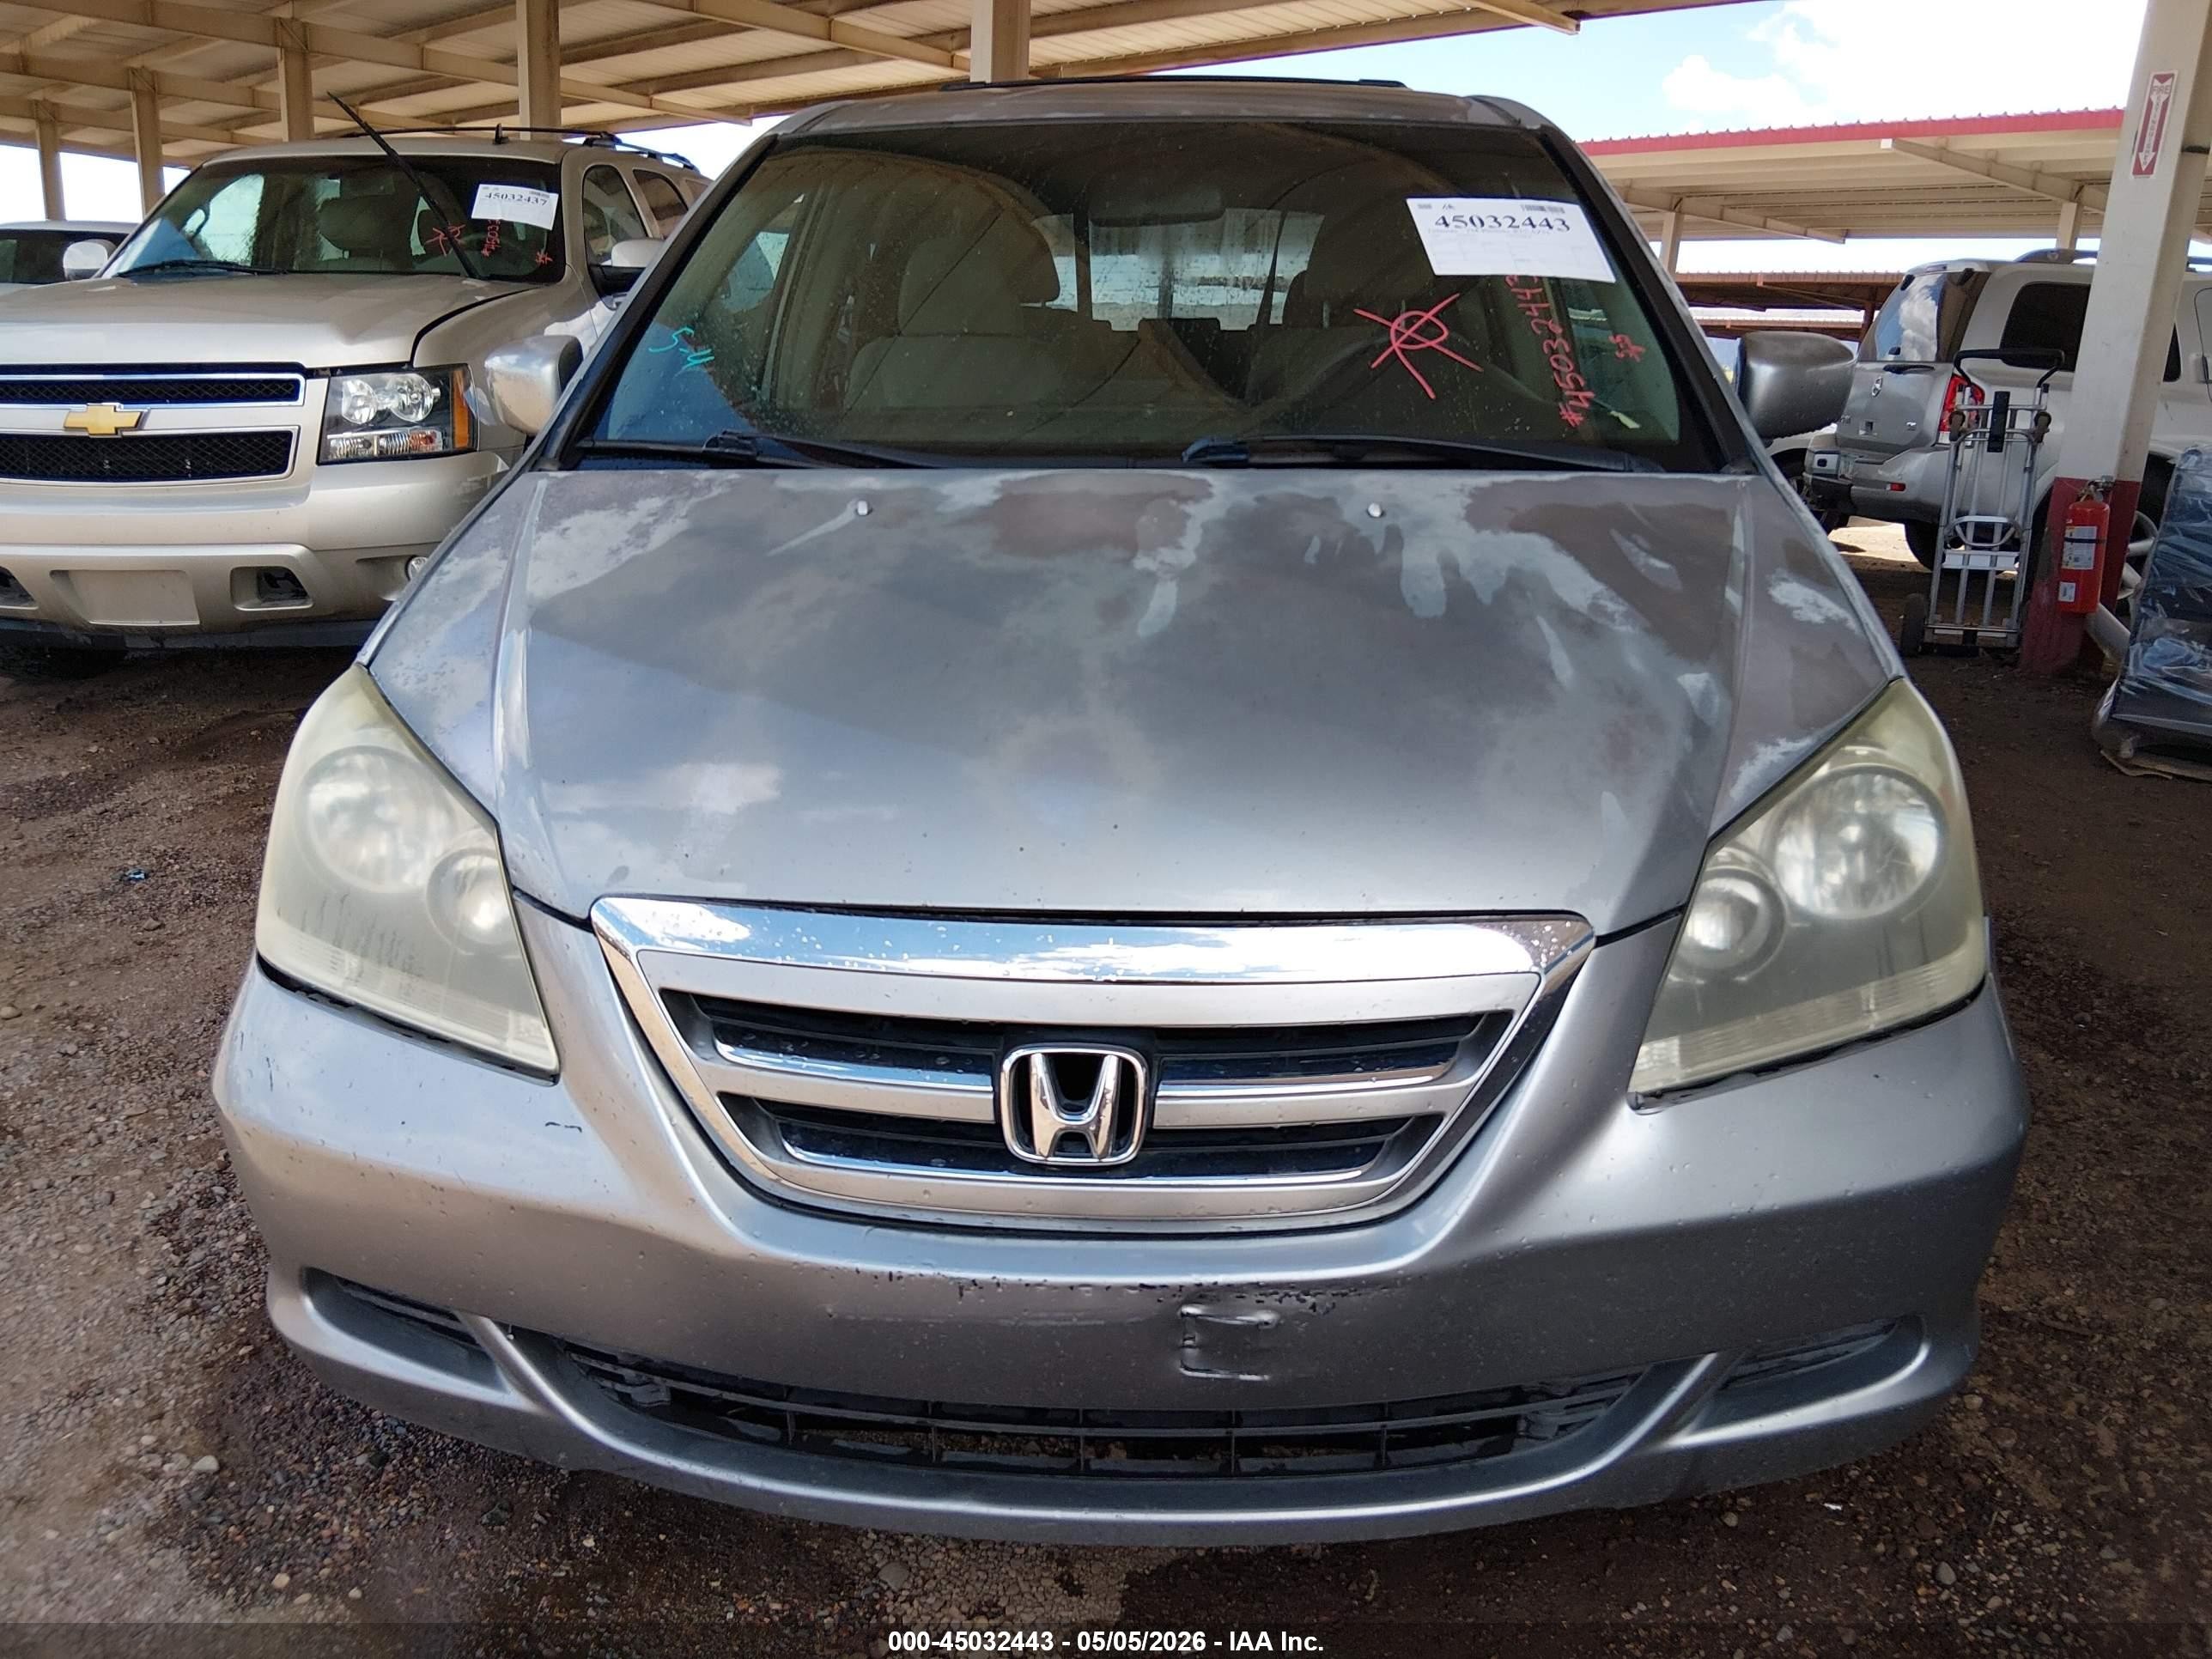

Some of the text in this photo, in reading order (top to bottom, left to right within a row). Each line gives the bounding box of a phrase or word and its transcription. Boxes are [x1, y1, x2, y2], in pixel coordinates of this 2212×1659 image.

[2151, 84, 2171, 94] FIRE
[485, 191, 548, 206] 45032437
[1434, 215, 1571, 232] 45032443
